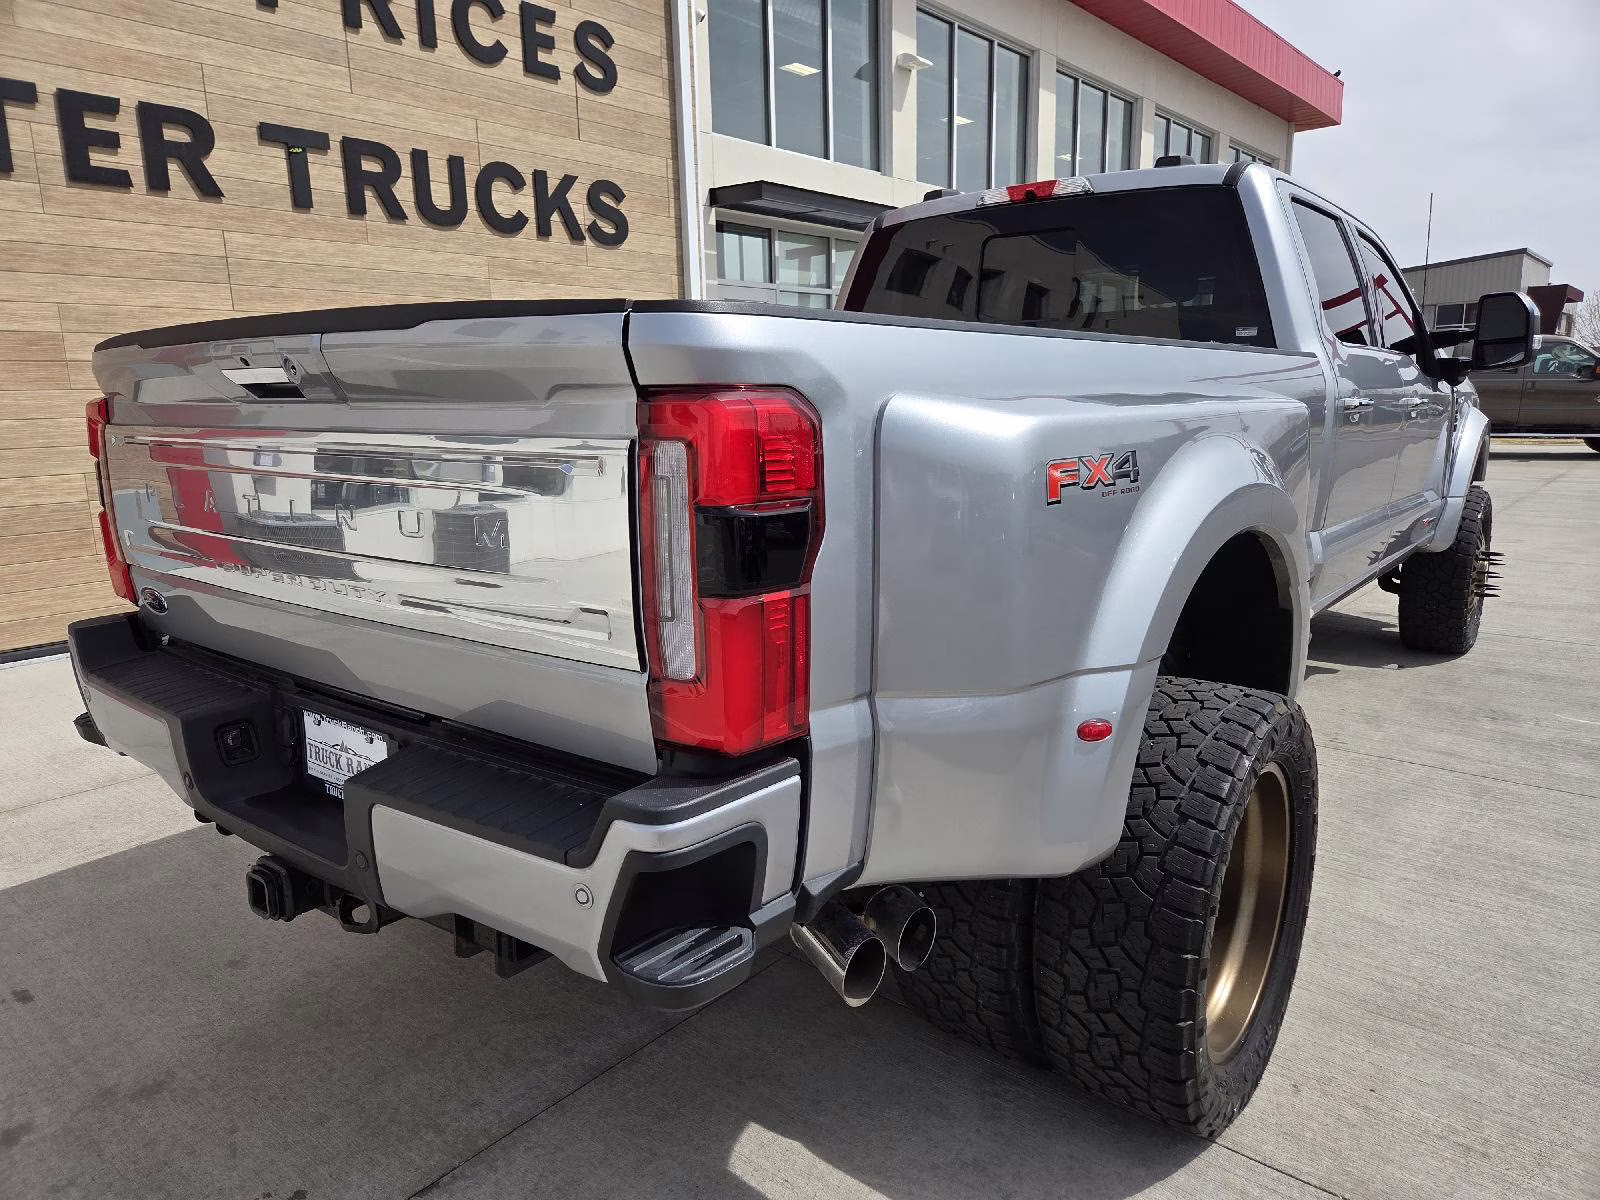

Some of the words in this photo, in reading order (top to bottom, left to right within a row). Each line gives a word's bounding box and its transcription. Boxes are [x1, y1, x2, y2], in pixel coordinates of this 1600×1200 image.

[256, 0, 619, 94] ICES
[257, 121, 630, 247] TRUCKS
[1045, 450, 1140, 506] FX4
[1101, 488, 1118, 498] OFF
[1120, 485, 1140, 495] ROAD
[308, 579, 387, 603] DUTY
[307, 742, 344, 772] TRUCK
